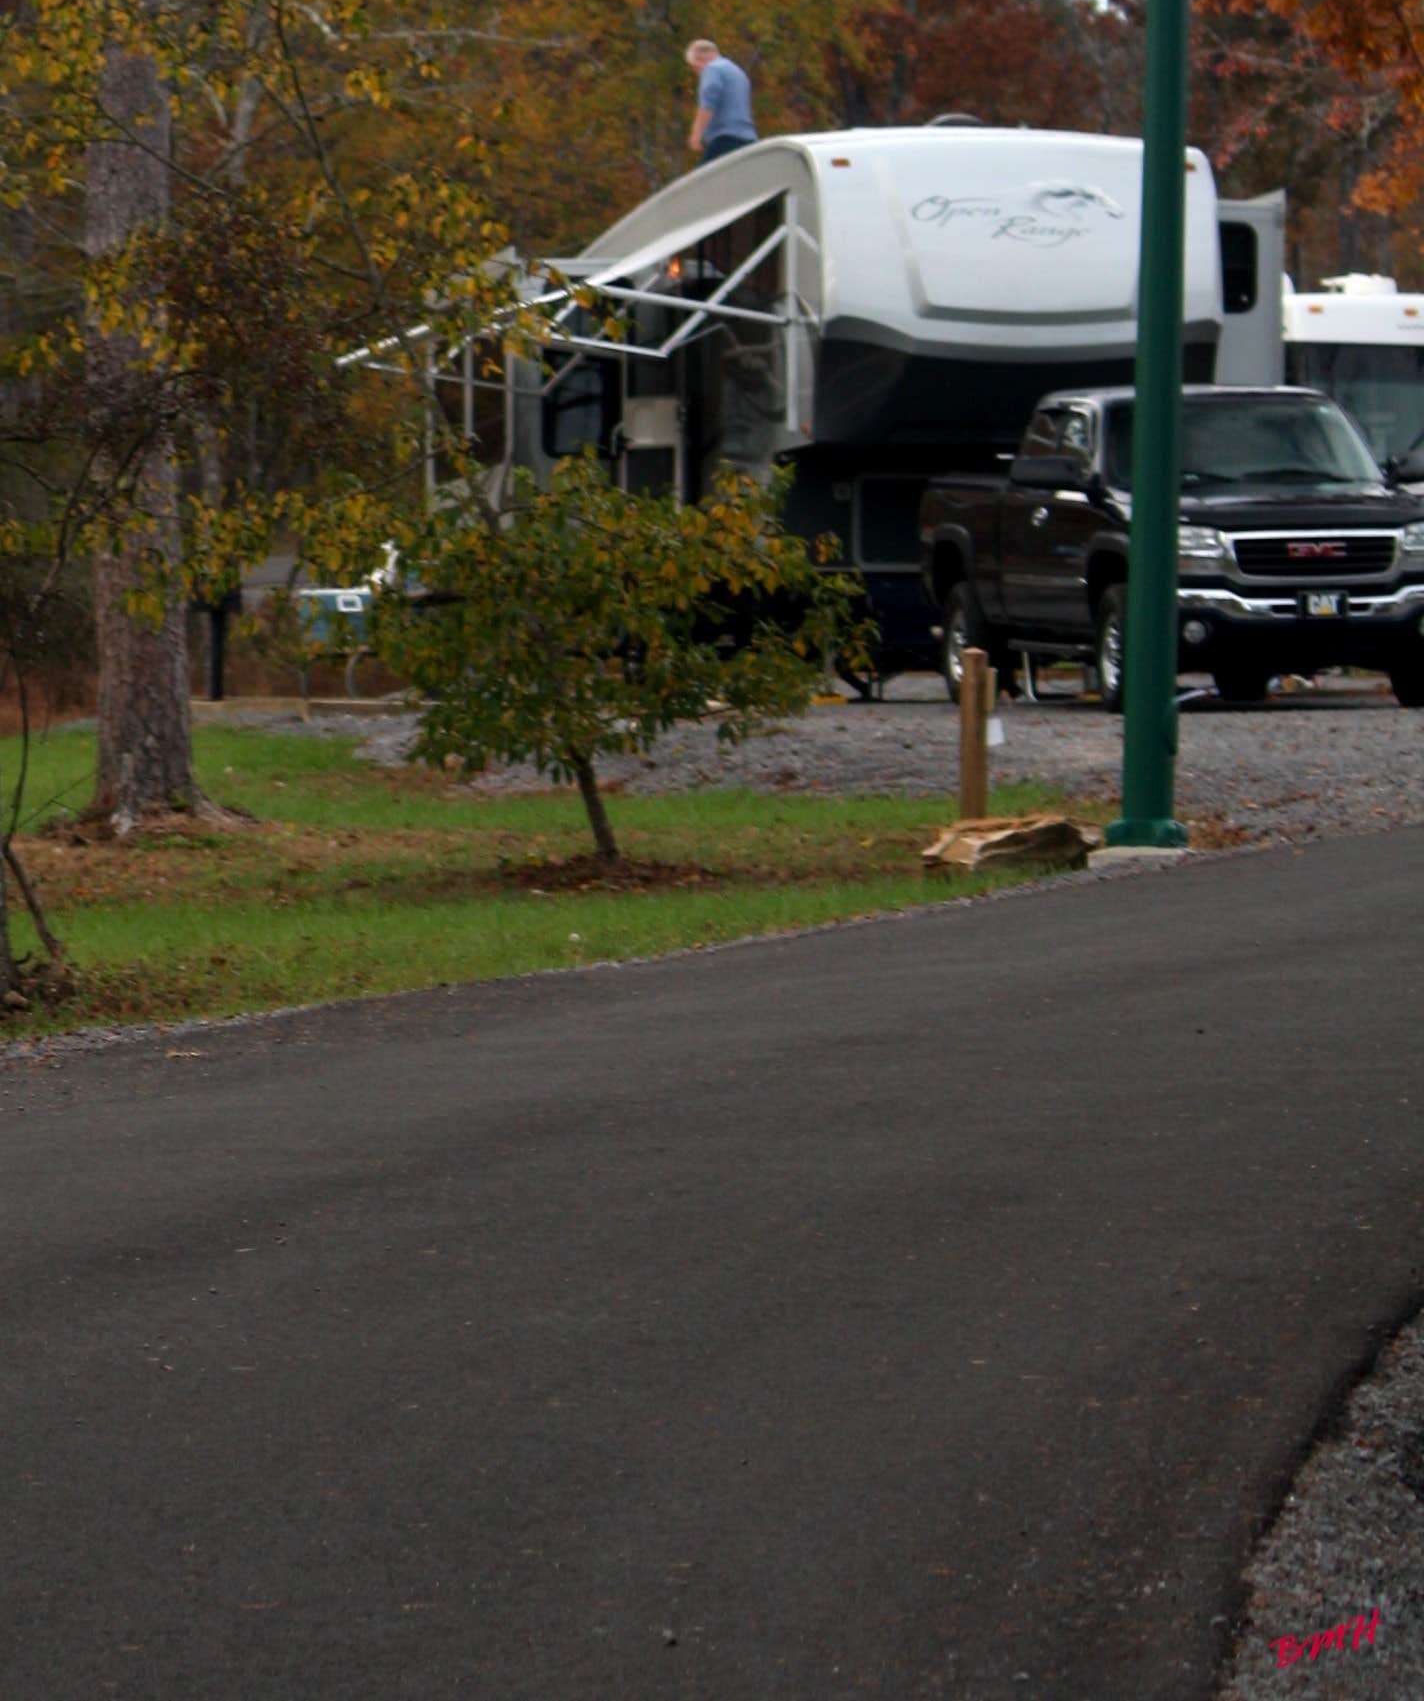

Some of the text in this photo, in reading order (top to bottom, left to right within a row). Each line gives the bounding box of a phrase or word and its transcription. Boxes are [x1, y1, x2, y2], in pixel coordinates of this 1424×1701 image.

[911, 195, 1001, 227] Open
[990, 215, 1091, 248] Range
[1287, 541, 1348, 558] GMC
[1308, 594, 1340, 616] CAT
